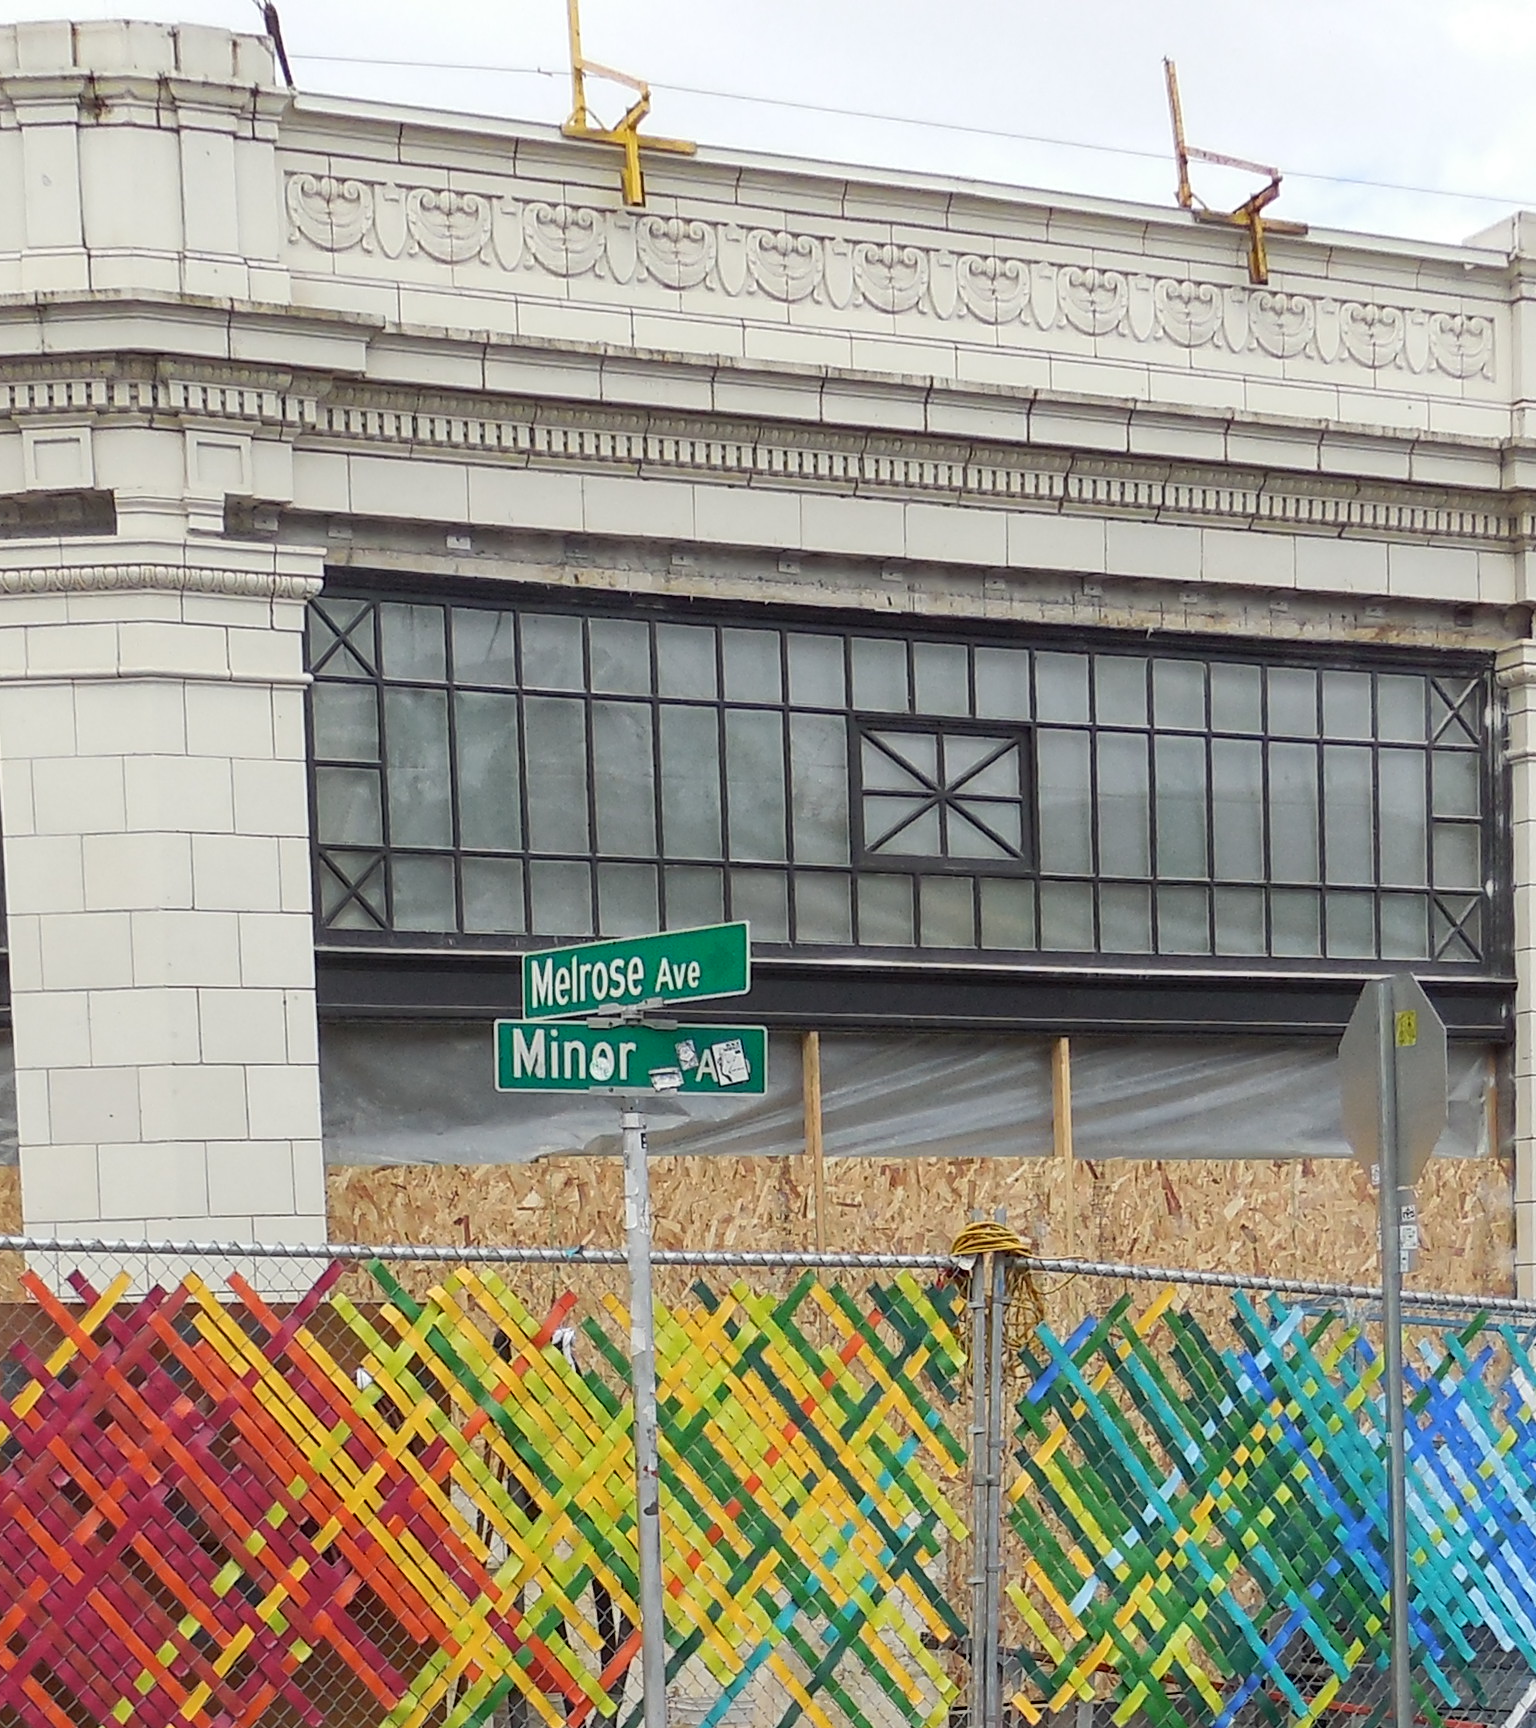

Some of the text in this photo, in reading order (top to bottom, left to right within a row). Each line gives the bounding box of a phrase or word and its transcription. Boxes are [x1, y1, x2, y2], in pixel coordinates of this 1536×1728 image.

[531, 956, 701, 1009] Melrose Ave
[513, 1027, 637, 1081] Minor
